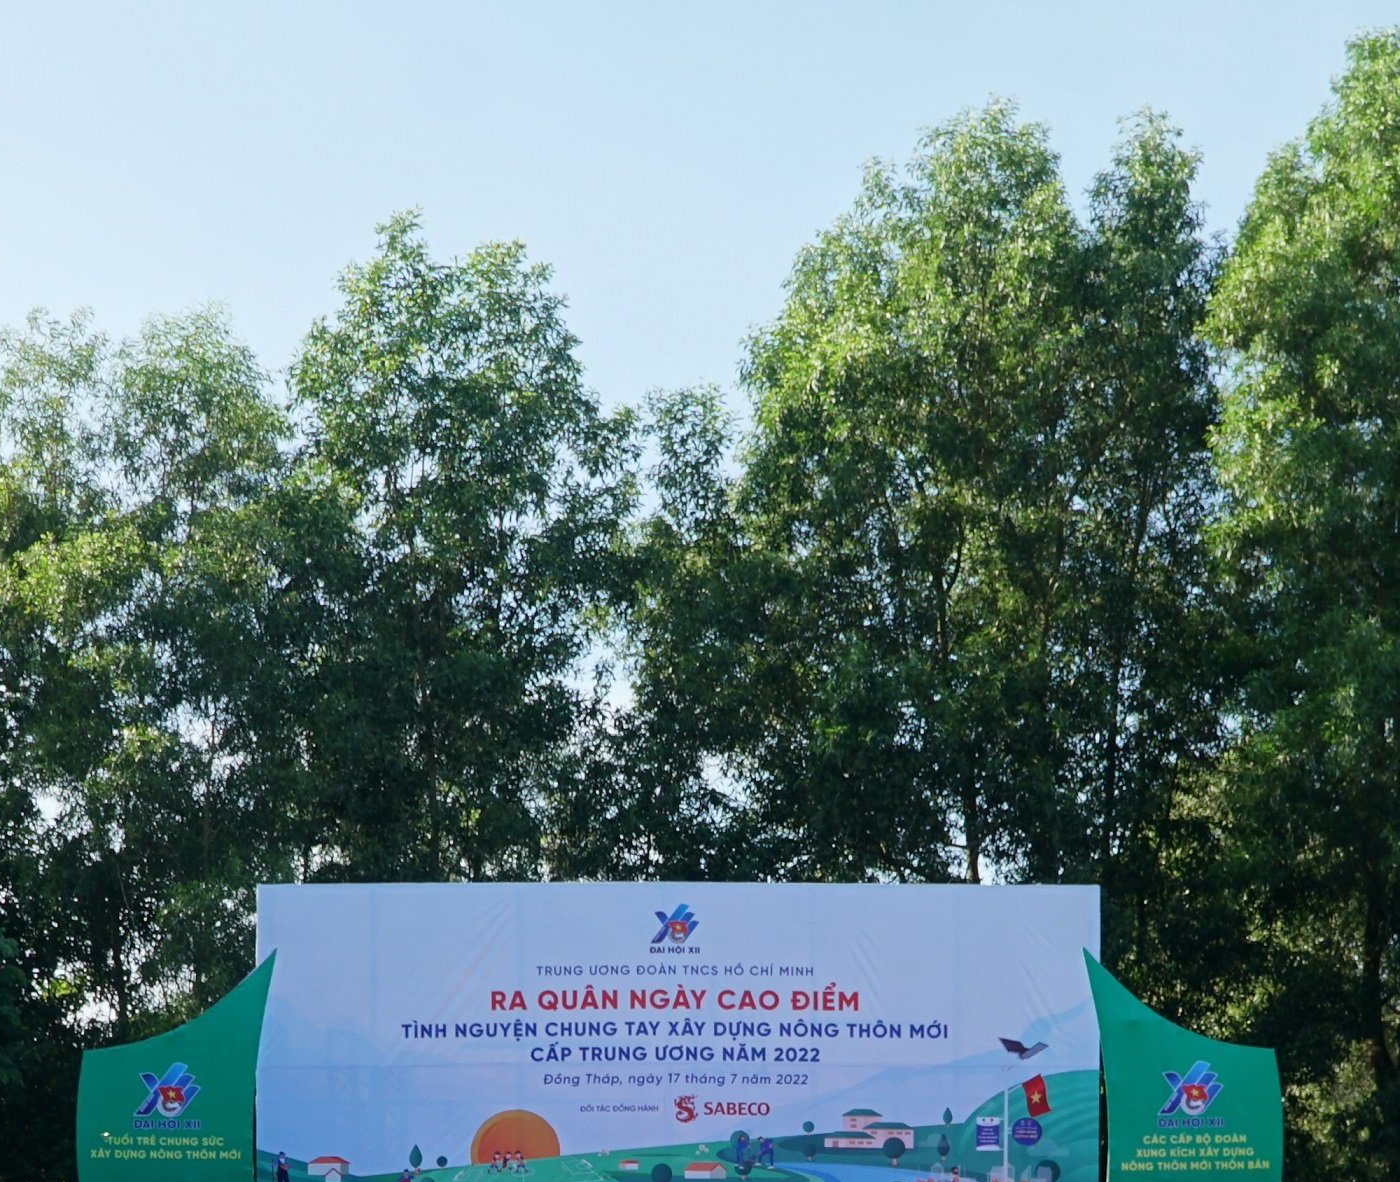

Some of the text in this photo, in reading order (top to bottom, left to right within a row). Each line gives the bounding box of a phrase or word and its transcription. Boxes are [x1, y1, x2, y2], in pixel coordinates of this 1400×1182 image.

[688, 946, 701, 954] XII
[536, 965, 583, 976] TRUNG
[589, 964, 630, 976] ƯƠNG
[636, 962, 677, 976] ĐOÀN
[682, 965, 719, 976] TNCS
[749, 963, 774, 976] CHÍ
[779, 966, 814, 977] MINH
[490, 982, 860, 1012] RA QUÂN NGÀY CAO ĐIỂM
[401, 1018, 948, 1042] TÌNH NGUYỆN CHUNG TAY XÂY DỰNG NÔNG THÔN MỚI
[530, 1041, 820, 1062] CẤP TRUNG ƯƠNG NĂM 2022
[585, 1073, 623, 1086] Tháp,
[628, 1074, 663, 1086] ngày
[667, 1073, 680, 1084] 17
[685, 1072, 726, 1087] tháng
[730, 1074, 738, 1084] 7
[741, 1074, 771, 1085] năm
[776, 1074, 809, 1085] 2022
[703, 1101, 770, 1116] SABECO
[184, 1119, 201, 1130] XII
[1208, 1117, 1224, 1127] XII
[159, 1136, 199, 1146] CHUNG
[1143, 1133, 1167, 1145] CÁC
[90, 1148, 111, 1159] XÂY
[114, 1149, 146, 1161] DỰNG
[149, 1147, 182, 1160] NÔNG
[186, 1148, 216, 1160] THÔN
[1136, 1148, 1166, 1158] XUNG
[1121, 1160, 1154, 1171] NÔNG
[1157, 1159, 1187, 1171] THÔN
[1215, 1159, 1245, 1170] THÔN
